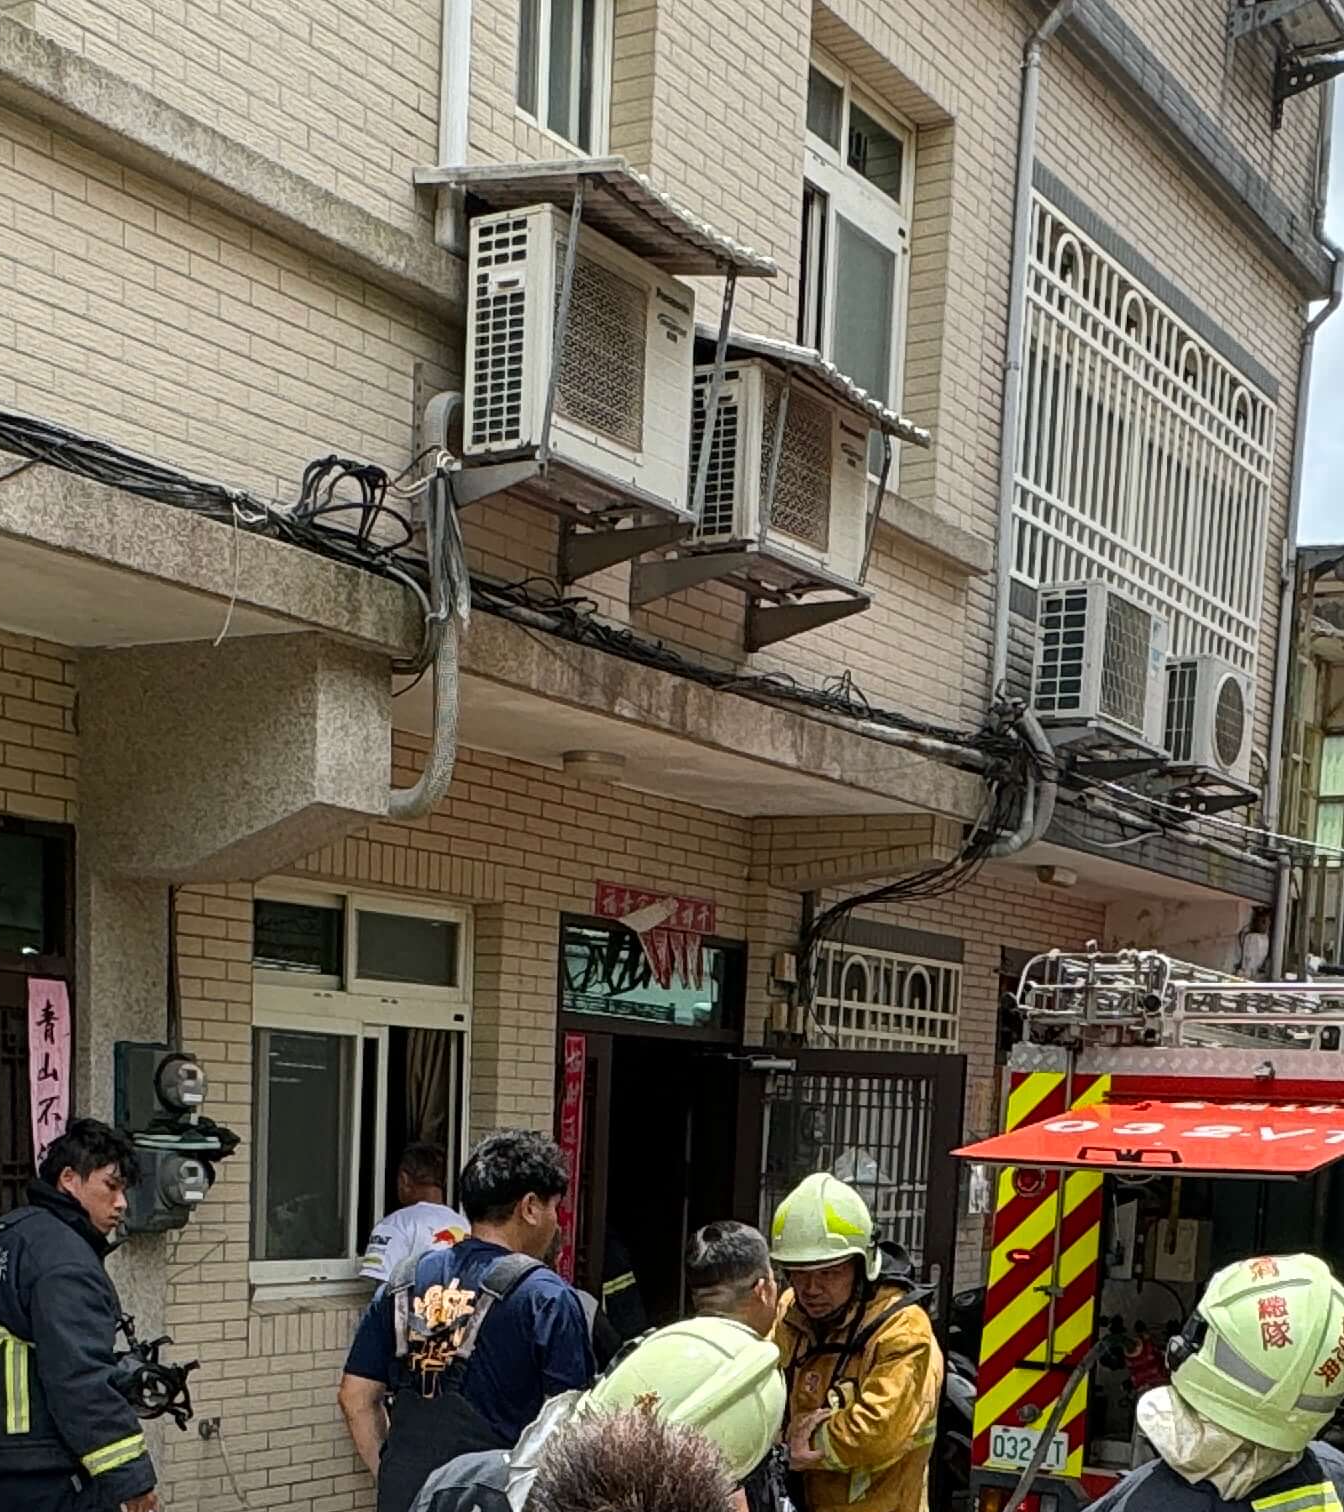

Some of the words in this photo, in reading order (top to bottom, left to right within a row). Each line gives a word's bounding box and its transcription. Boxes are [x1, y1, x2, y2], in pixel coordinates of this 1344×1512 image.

[36, 999, 63, 1162] 青山不
[992, 1434, 1065, 1466] 032-T
